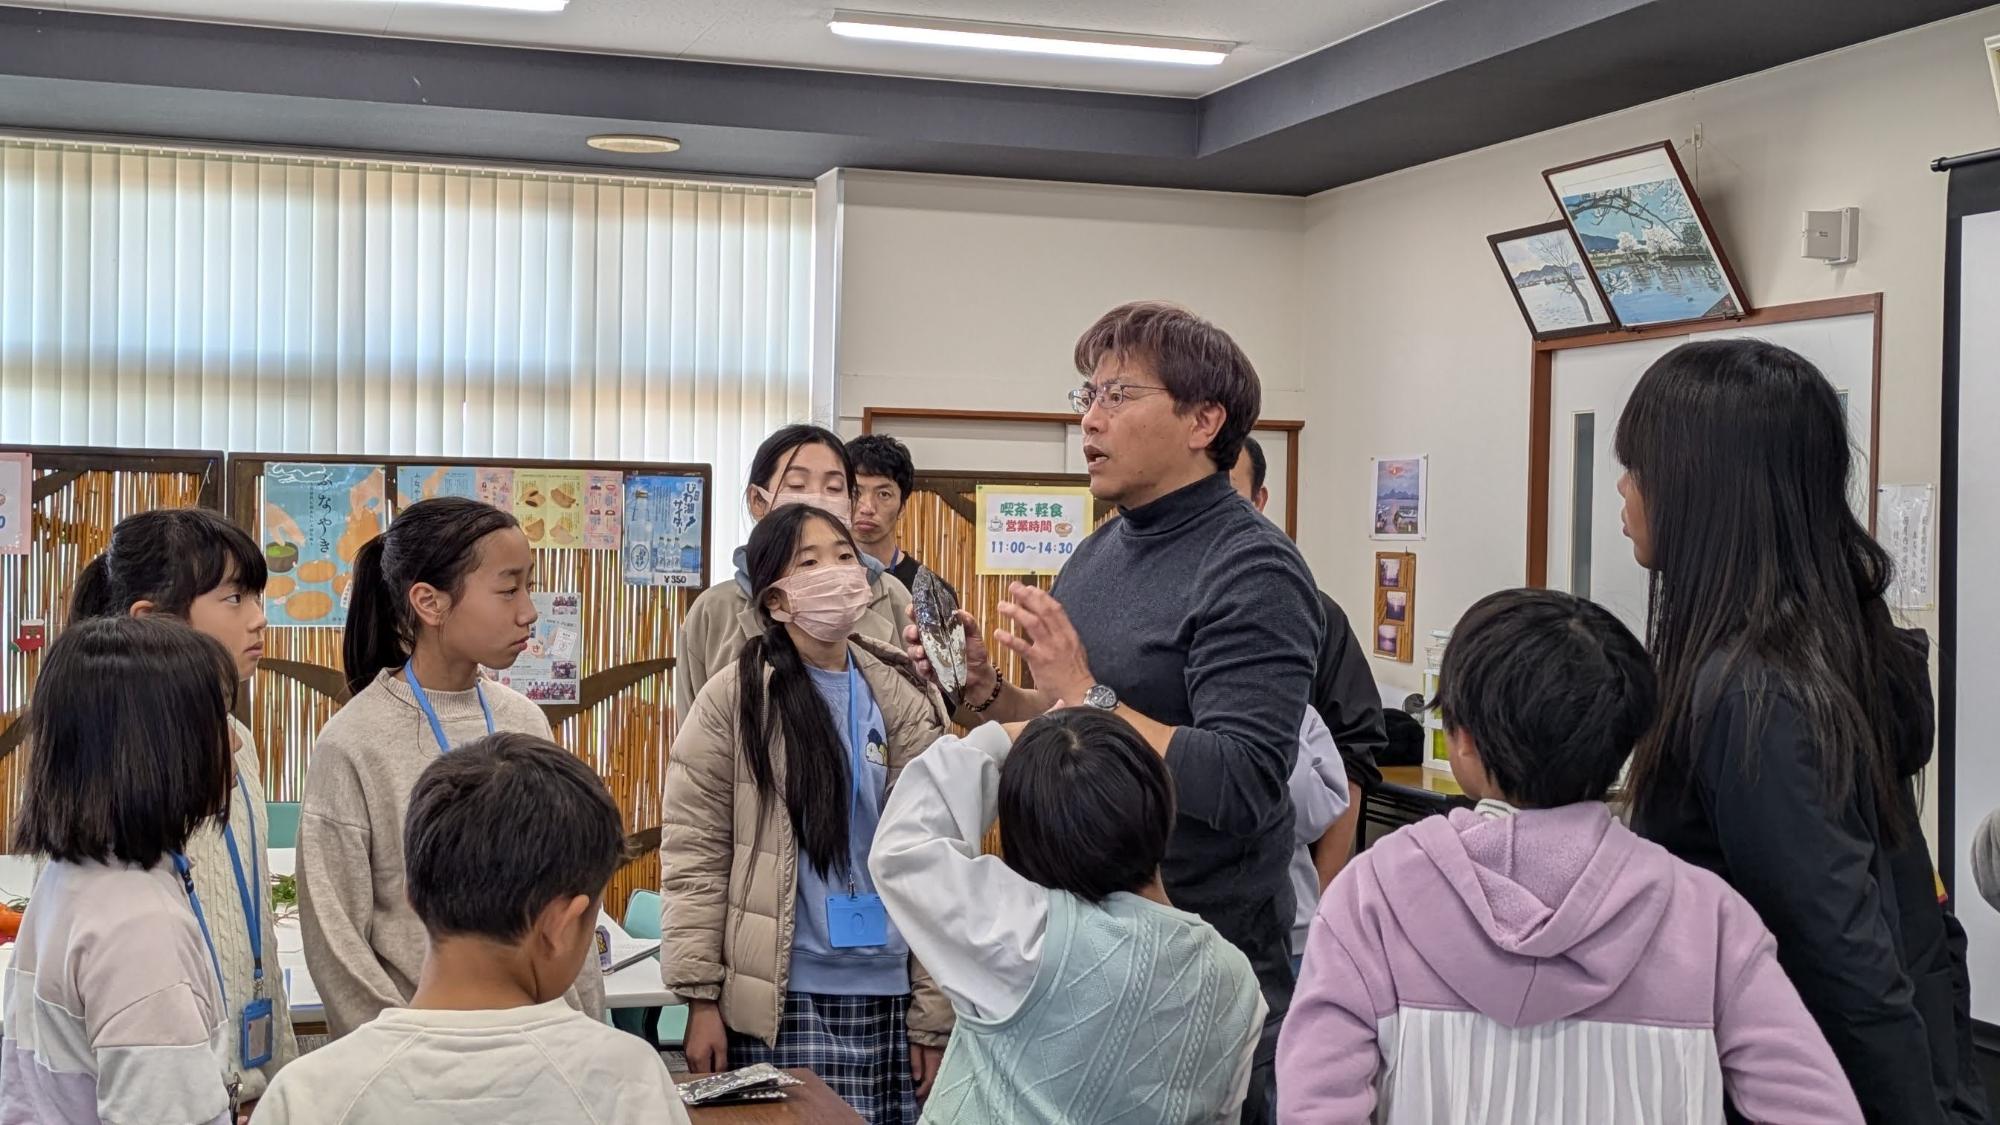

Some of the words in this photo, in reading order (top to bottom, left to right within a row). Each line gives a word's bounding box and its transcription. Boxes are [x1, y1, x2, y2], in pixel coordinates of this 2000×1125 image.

[672, 499, 683, 535] サイダー
[1000, 502, 1064, 518] 喫茶・軽食
[1005, 519, 1052, 533] 営業時間
